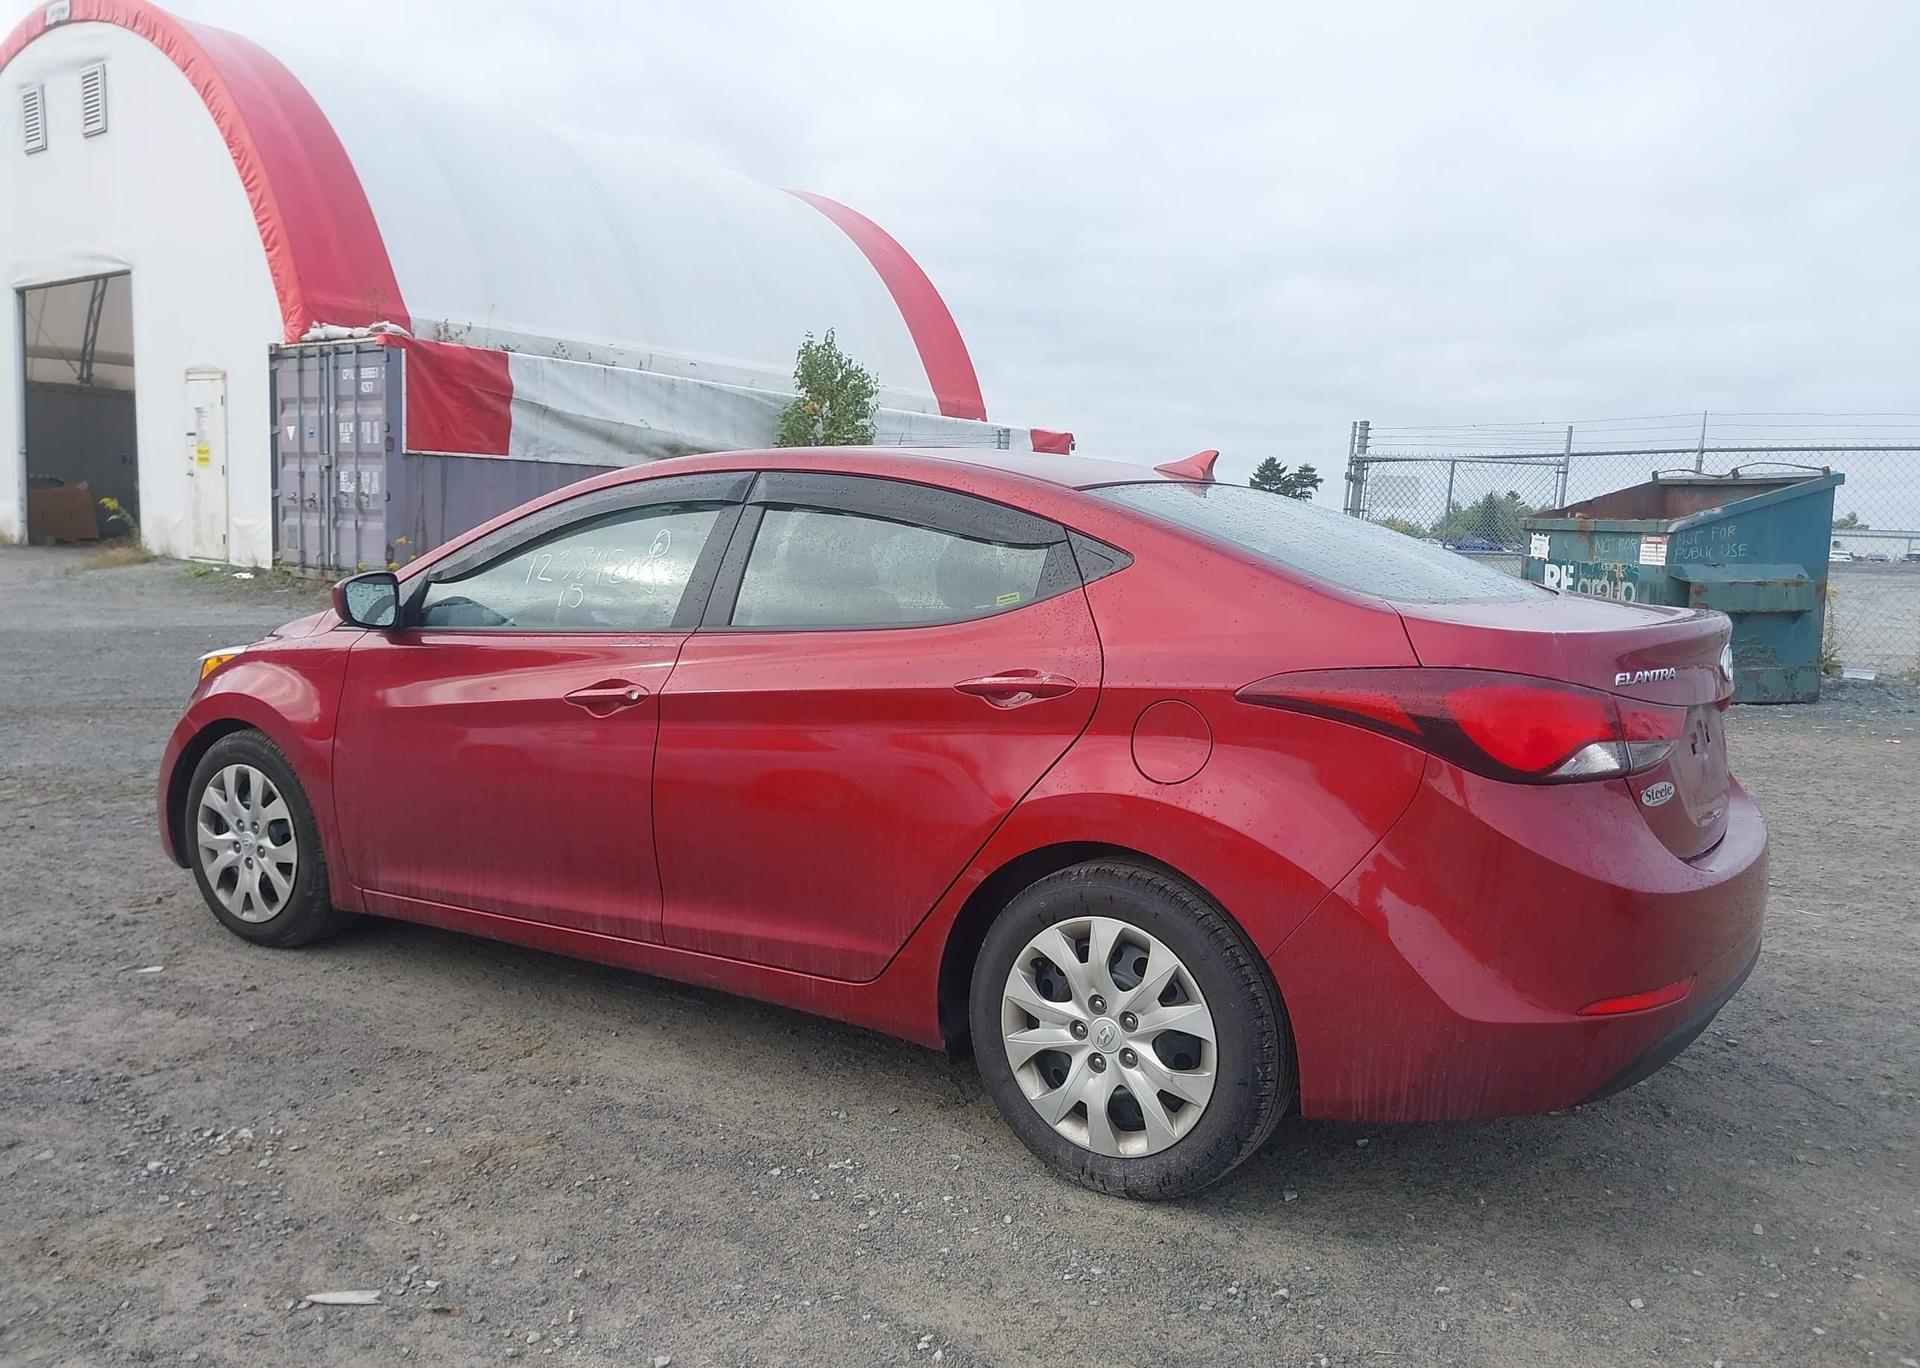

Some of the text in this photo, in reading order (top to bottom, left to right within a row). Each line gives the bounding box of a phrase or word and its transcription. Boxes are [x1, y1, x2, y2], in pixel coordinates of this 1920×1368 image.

[1711, 525, 1736, 540] FOR
[1673, 546, 1714, 561] PUBLIC
[1720, 543, 1748, 558] USE
[1615, 668, 1676, 686] ELANTRA
[1645, 784, 1673, 803] Steele
